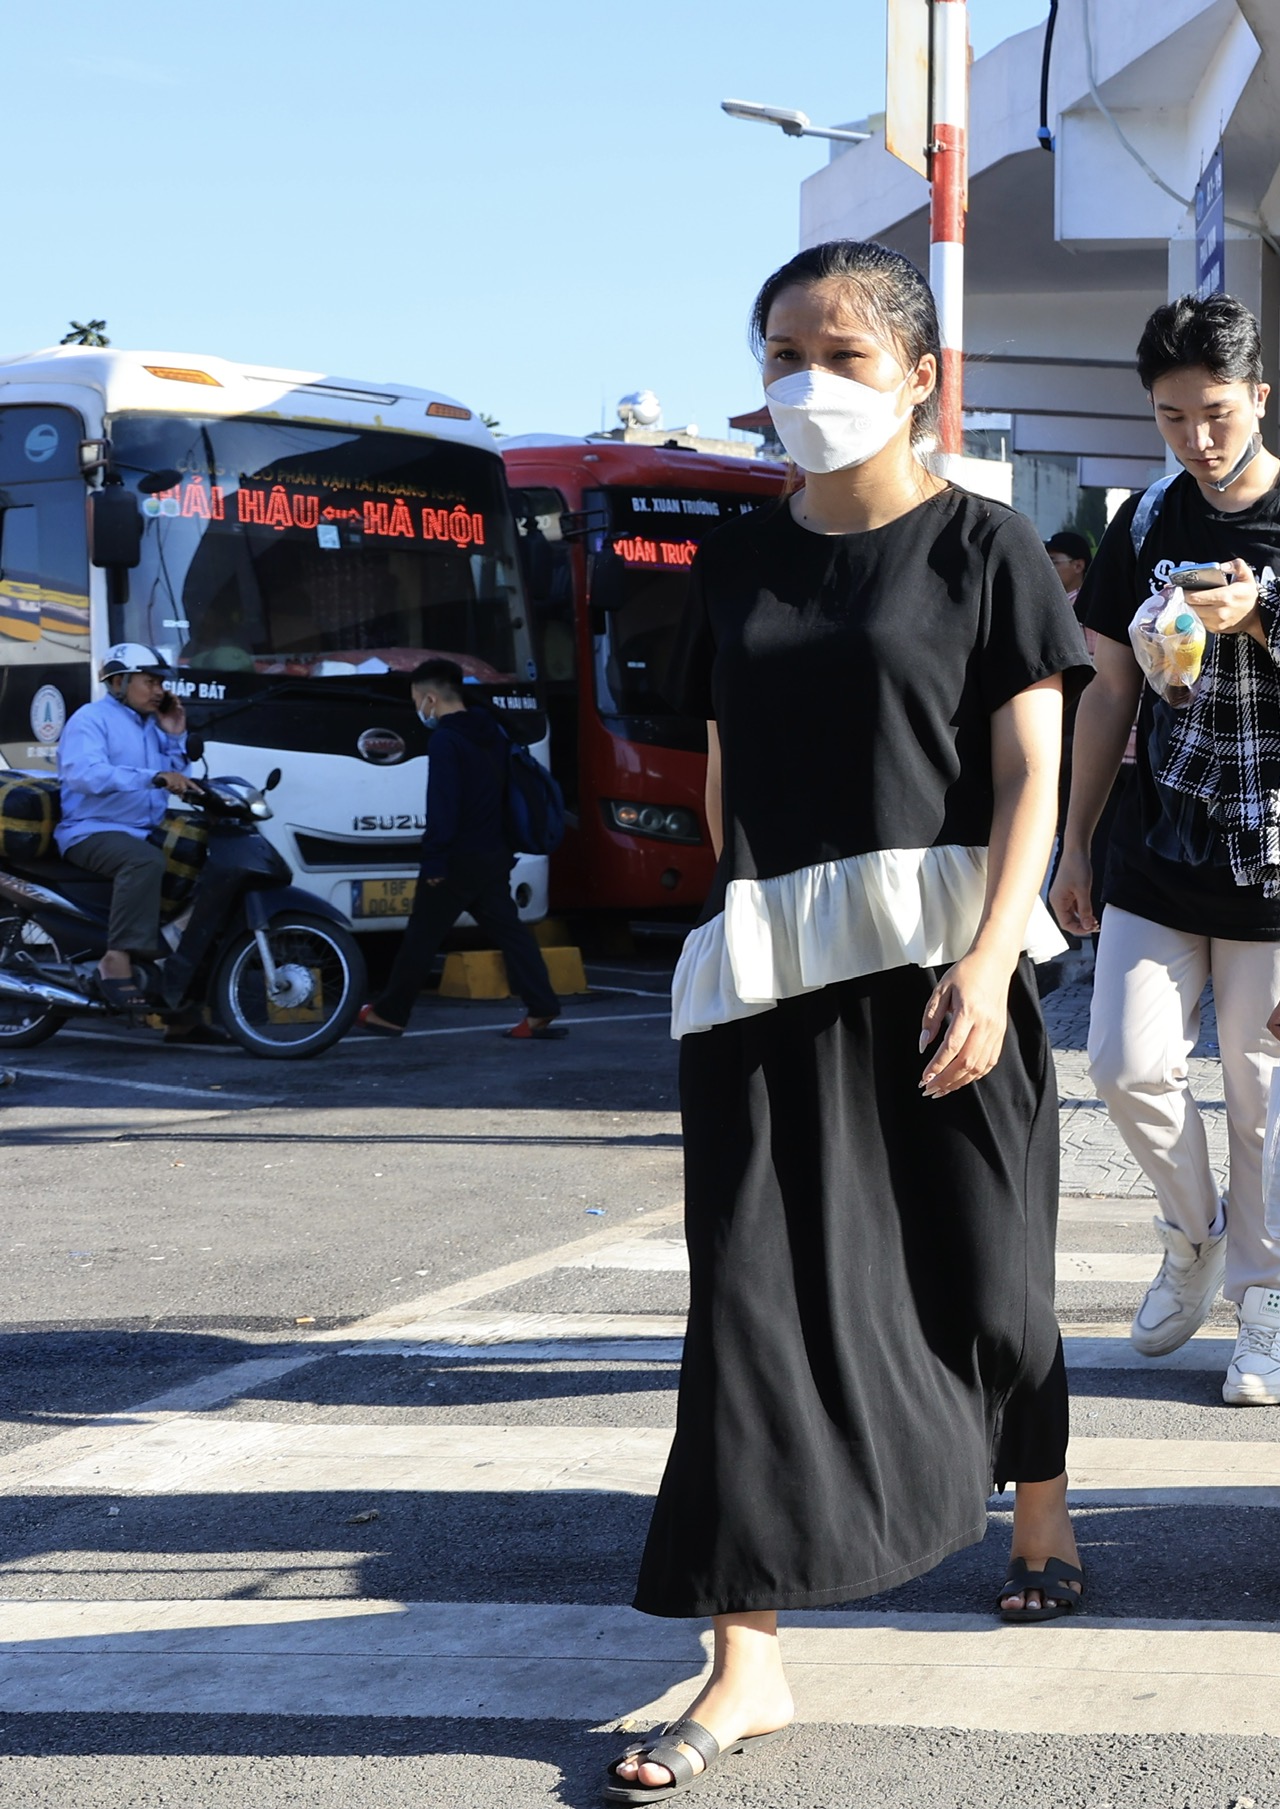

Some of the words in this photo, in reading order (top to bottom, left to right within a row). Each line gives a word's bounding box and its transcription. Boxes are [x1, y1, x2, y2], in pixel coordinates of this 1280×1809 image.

[237, 485, 319, 531] HẬU
[363, 498, 415, 538] HÀ
[422, 504, 485, 548] NỘI
[659, 539, 698, 565] TRƯỜ
[353, 814, 427, 831] ISUZU
